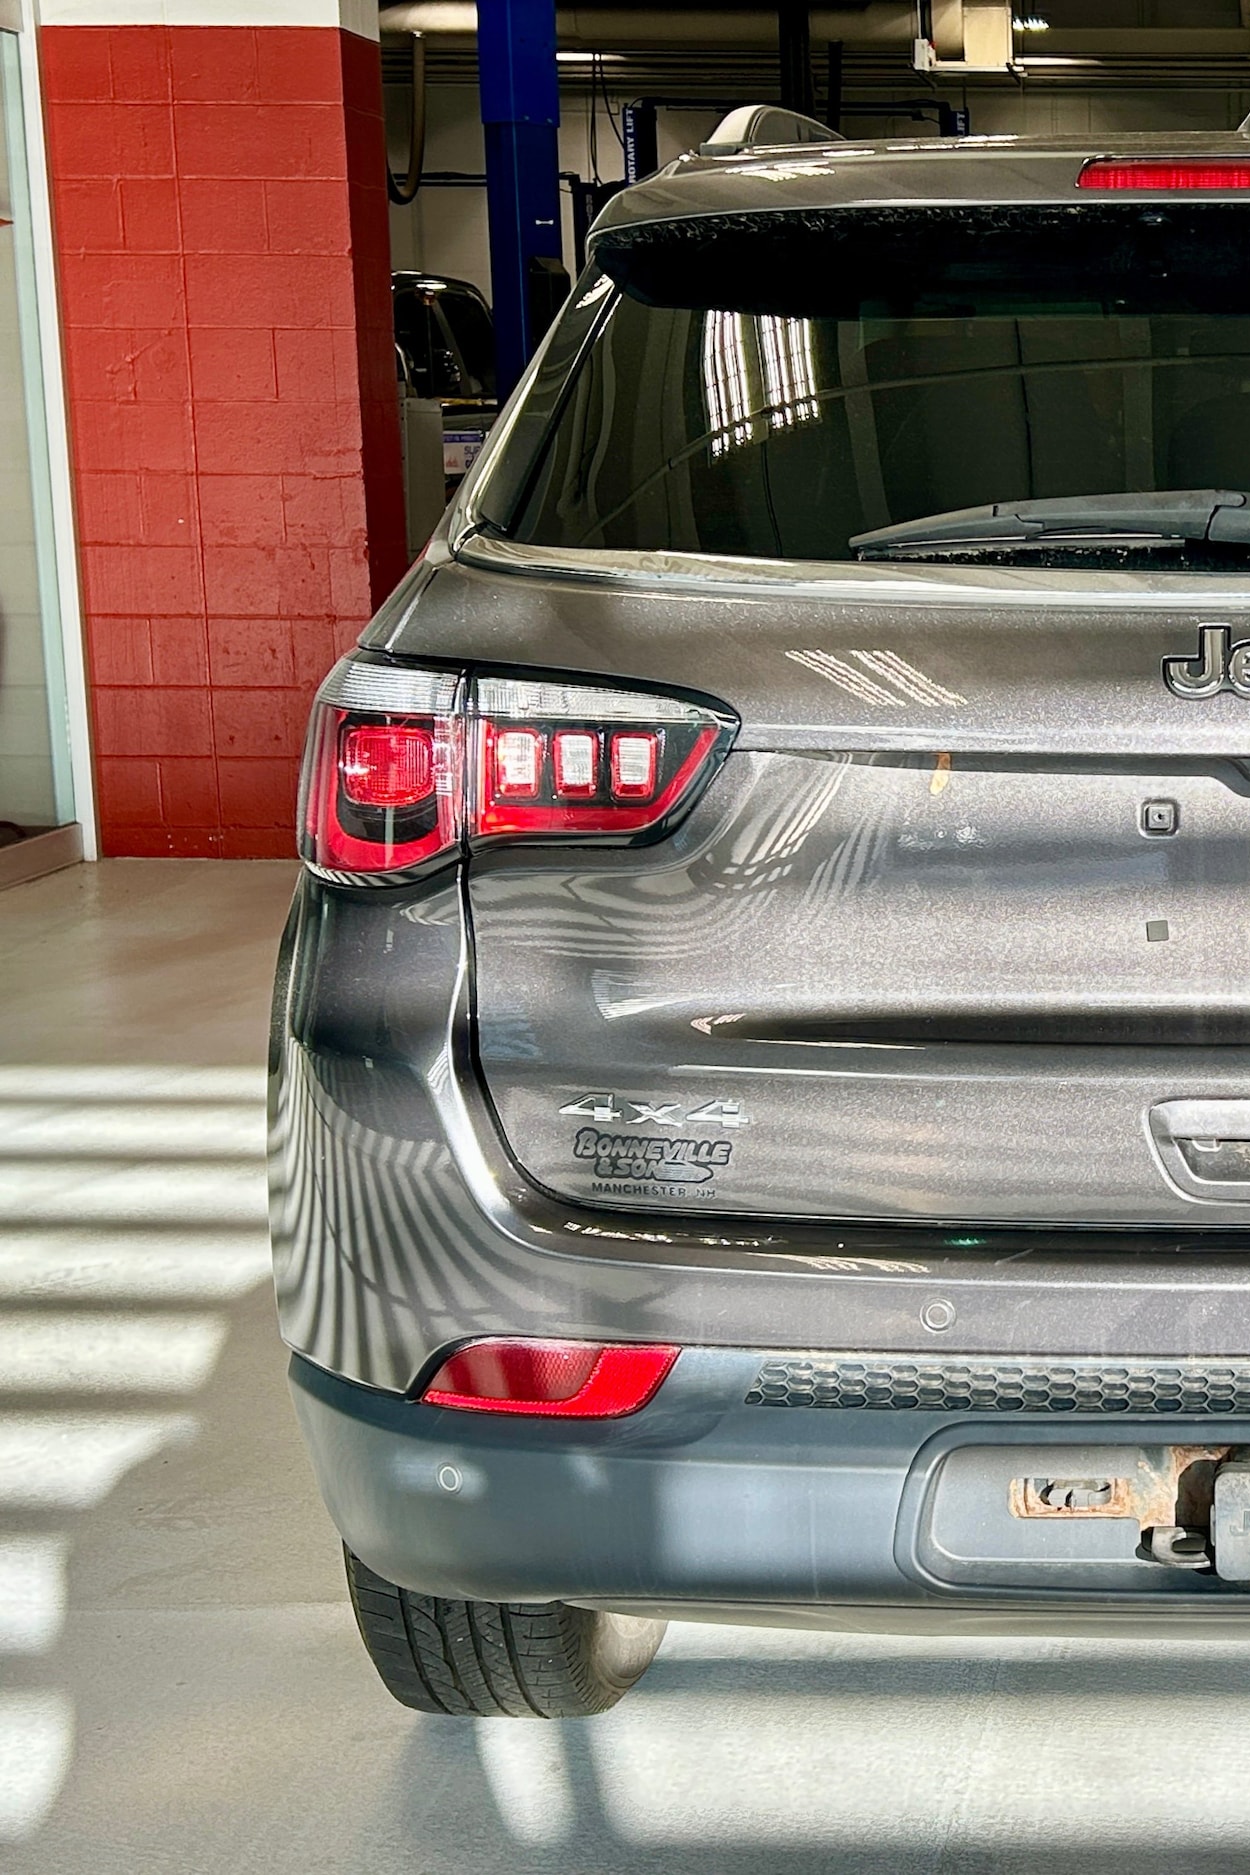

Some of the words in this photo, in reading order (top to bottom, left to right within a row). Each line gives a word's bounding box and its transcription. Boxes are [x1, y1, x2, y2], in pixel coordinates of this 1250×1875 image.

[625, 108, 634, 133] LIFT
[626, 136, 636, 184] ROTARY
[574, 1127, 732, 1165] BONNEVILLE
[598, 1157, 613, 1176] &
[591, 1181, 687, 1197] MANCHESTER
[696, 1188, 716, 1198] NH
